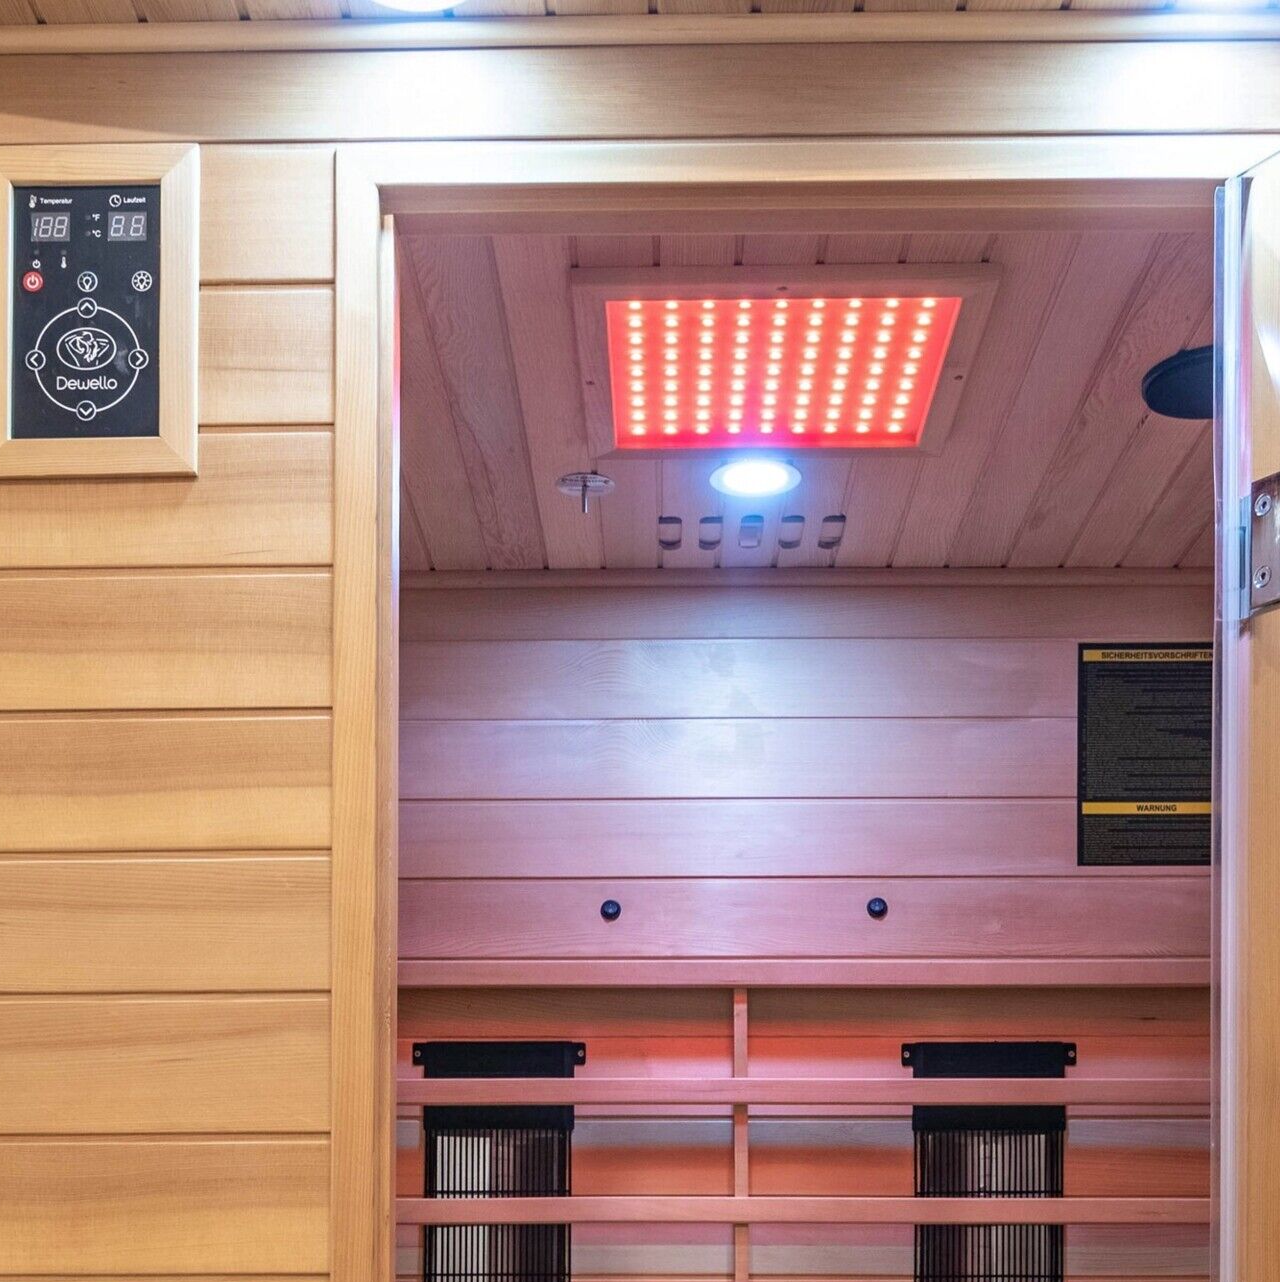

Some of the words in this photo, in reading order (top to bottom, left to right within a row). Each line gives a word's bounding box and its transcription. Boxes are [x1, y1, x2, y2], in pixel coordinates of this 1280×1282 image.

[40, 197, 73, 206] Temperatur
[56, 375, 118, 390] Dewello
[1136, 804, 1177, 812] WARNUNG
